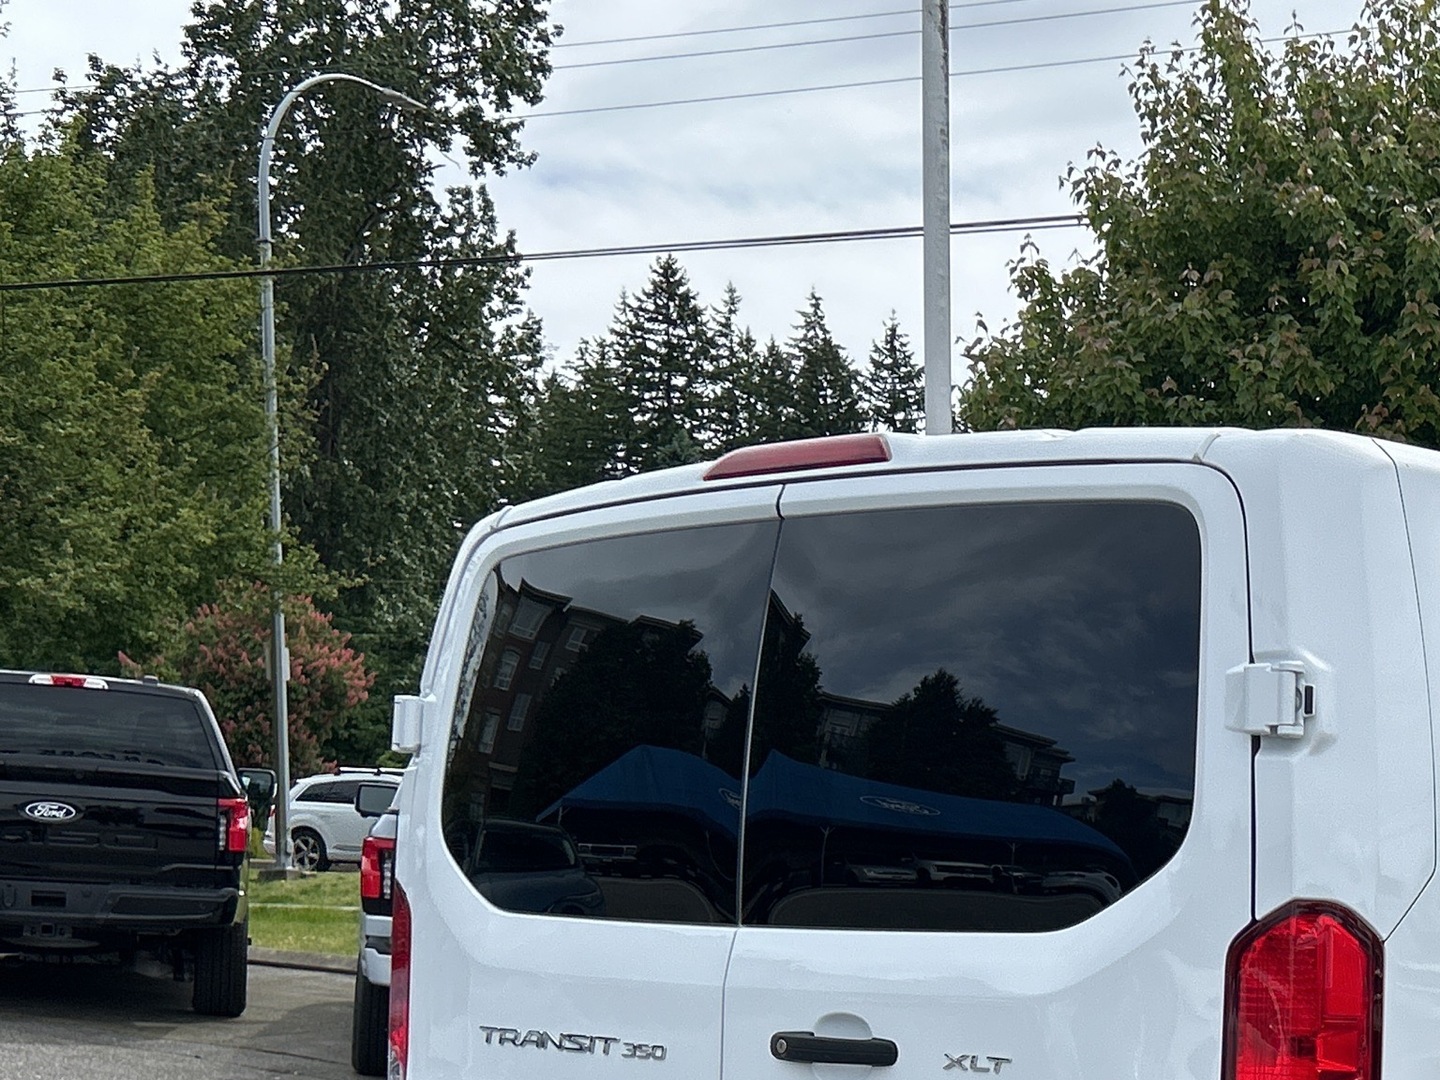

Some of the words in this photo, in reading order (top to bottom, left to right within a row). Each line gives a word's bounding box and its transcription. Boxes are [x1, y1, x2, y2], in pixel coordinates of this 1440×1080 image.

[33, 804, 66, 818] Ford
[479, 1025, 621, 1055] TRANSIT
[621, 1041, 667, 1061] 350
[942, 1053, 1012, 1075] XLT
